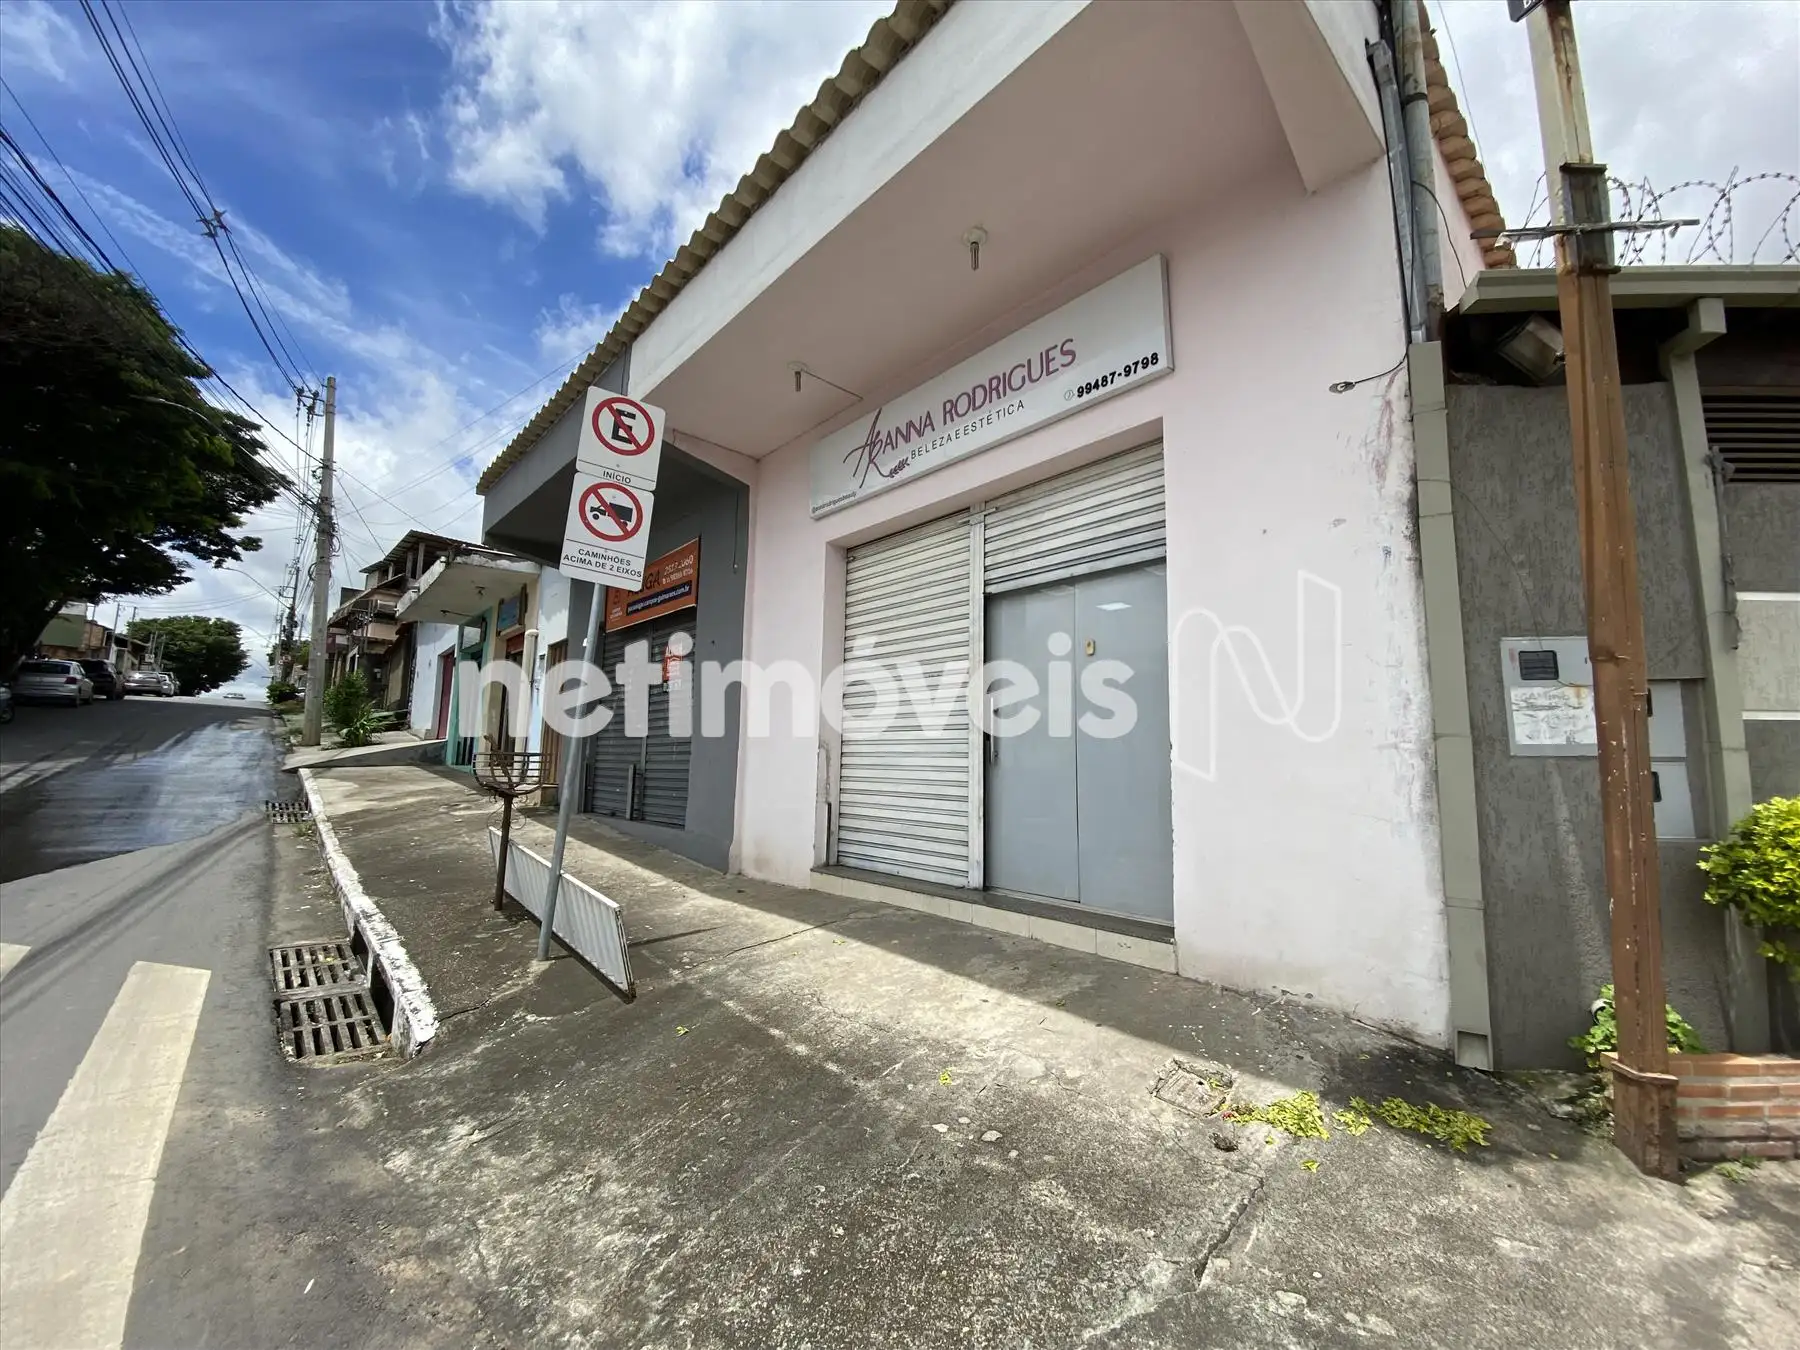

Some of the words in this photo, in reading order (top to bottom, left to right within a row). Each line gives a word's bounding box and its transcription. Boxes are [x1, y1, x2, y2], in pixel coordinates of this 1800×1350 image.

[1077, 352, 1159, 398] 99487-9798
[882, 410, 936, 455] ANNA
[942, 338, 1077, 426] RODRIGUES
[911, 433, 952, 459] BELEZA
[963, 400, 1025, 436] ESTÉTICA
[603, 470, 631, 484] INÍCIO
[563, 554, 592, 567] ACIMA
[595, 561, 607, 570] DE
[616, 566, 642, 578] EIXOS
[578, 548, 631, 567] CAMINHÕES
